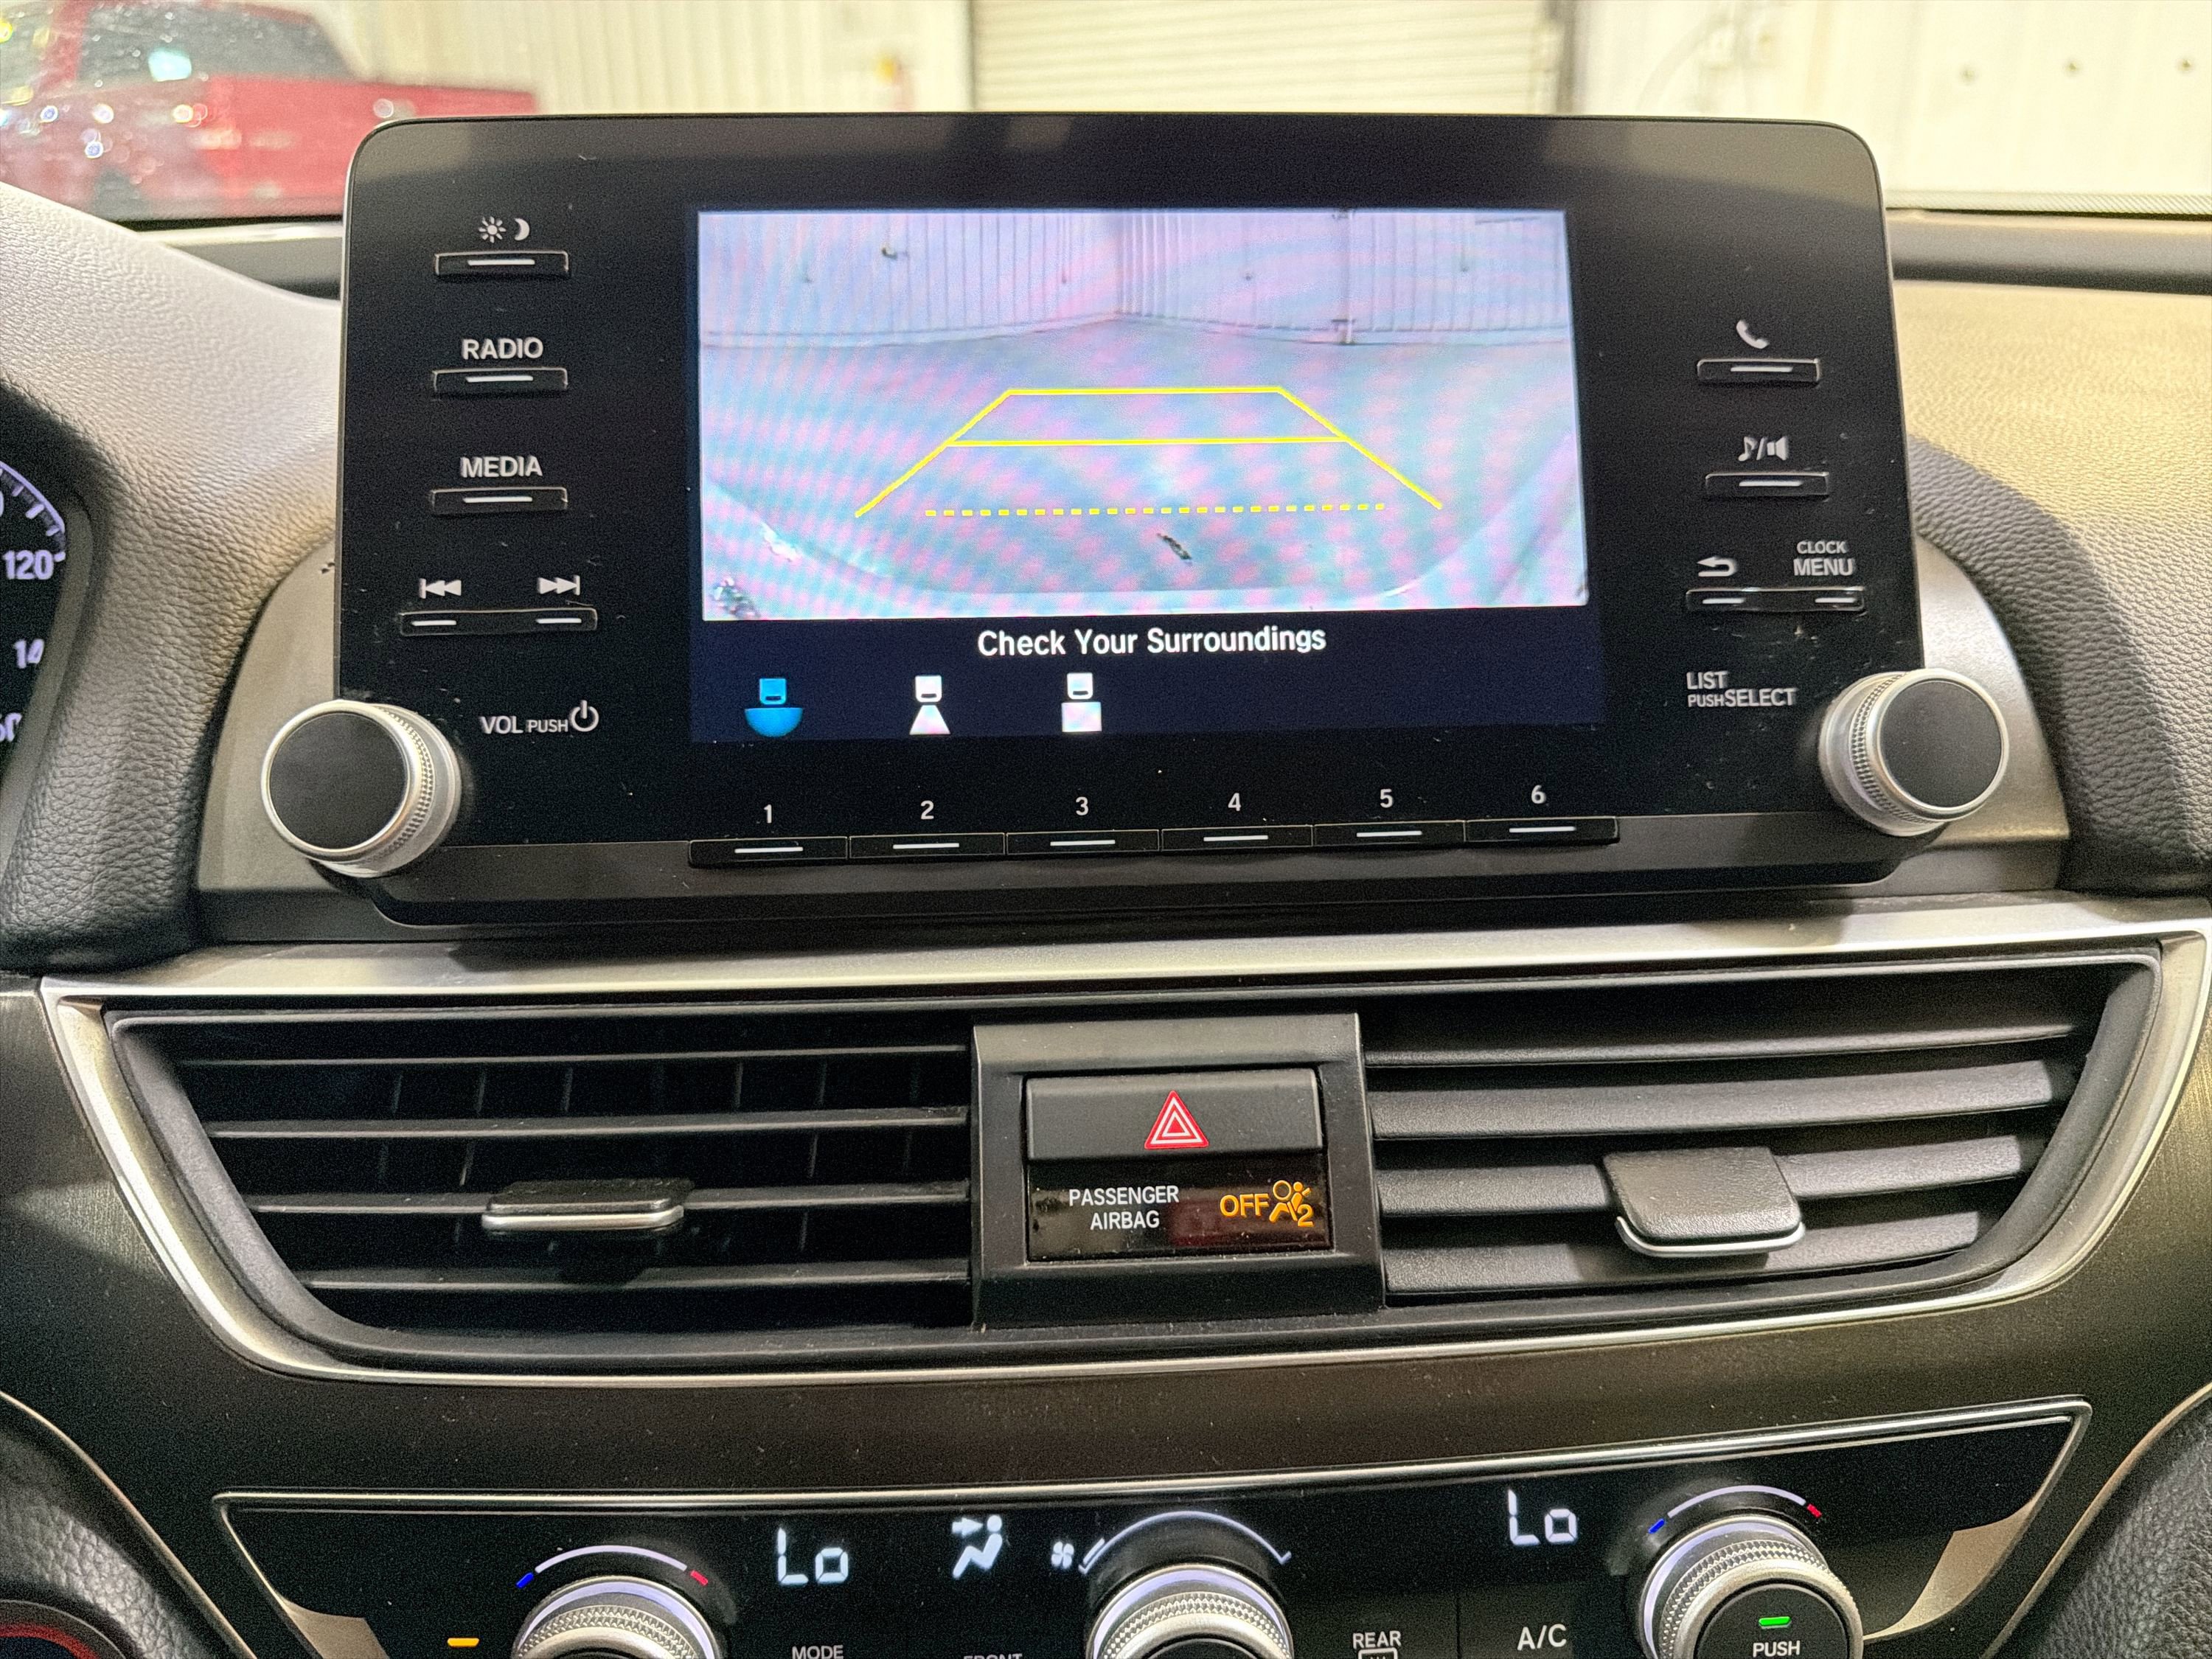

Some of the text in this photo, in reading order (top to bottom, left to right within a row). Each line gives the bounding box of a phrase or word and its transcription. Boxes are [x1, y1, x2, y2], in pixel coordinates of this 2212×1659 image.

[462, 337, 544, 360] RADIO
[460, 455, 543, 479] MEDIA
[1796, 540, 1848, 554] CLOCK
[2, 549, 54, 580] 120
[1792, 557, 1855, 577] MENU
[977, 625, 1327, 656] Check Your Surroundings
[1686, 670, 1729, 690] LIST
[479, 715, 568, 734] VOL PUSH
[1227, 792, 1242, 812] 4
[1380, 788, 1394, 808] 5
[1531, 784, 1545, 804] 6
[764, 804, 773, 824] 1
[919, 800, 935, 820] 2
[1076, 796, 1089, 816] 3
[1068, 1185, 1180, 1207] PASSENGER
[1220, 1193, 1270, 1217] OFF
[1090, 1210, 1161, 1231] AIRBAG
[1507, 1489, 1578, 1546] Lo
[776, 1527, 850, 1586] Lo
[1352, 1630, 1402, 1649] REAR
[1517, 1624, 1568, 1652] A/C
[791, 1644, 844, 1659] MODE
[1752, 1640, 1801, 1658] PUSH
